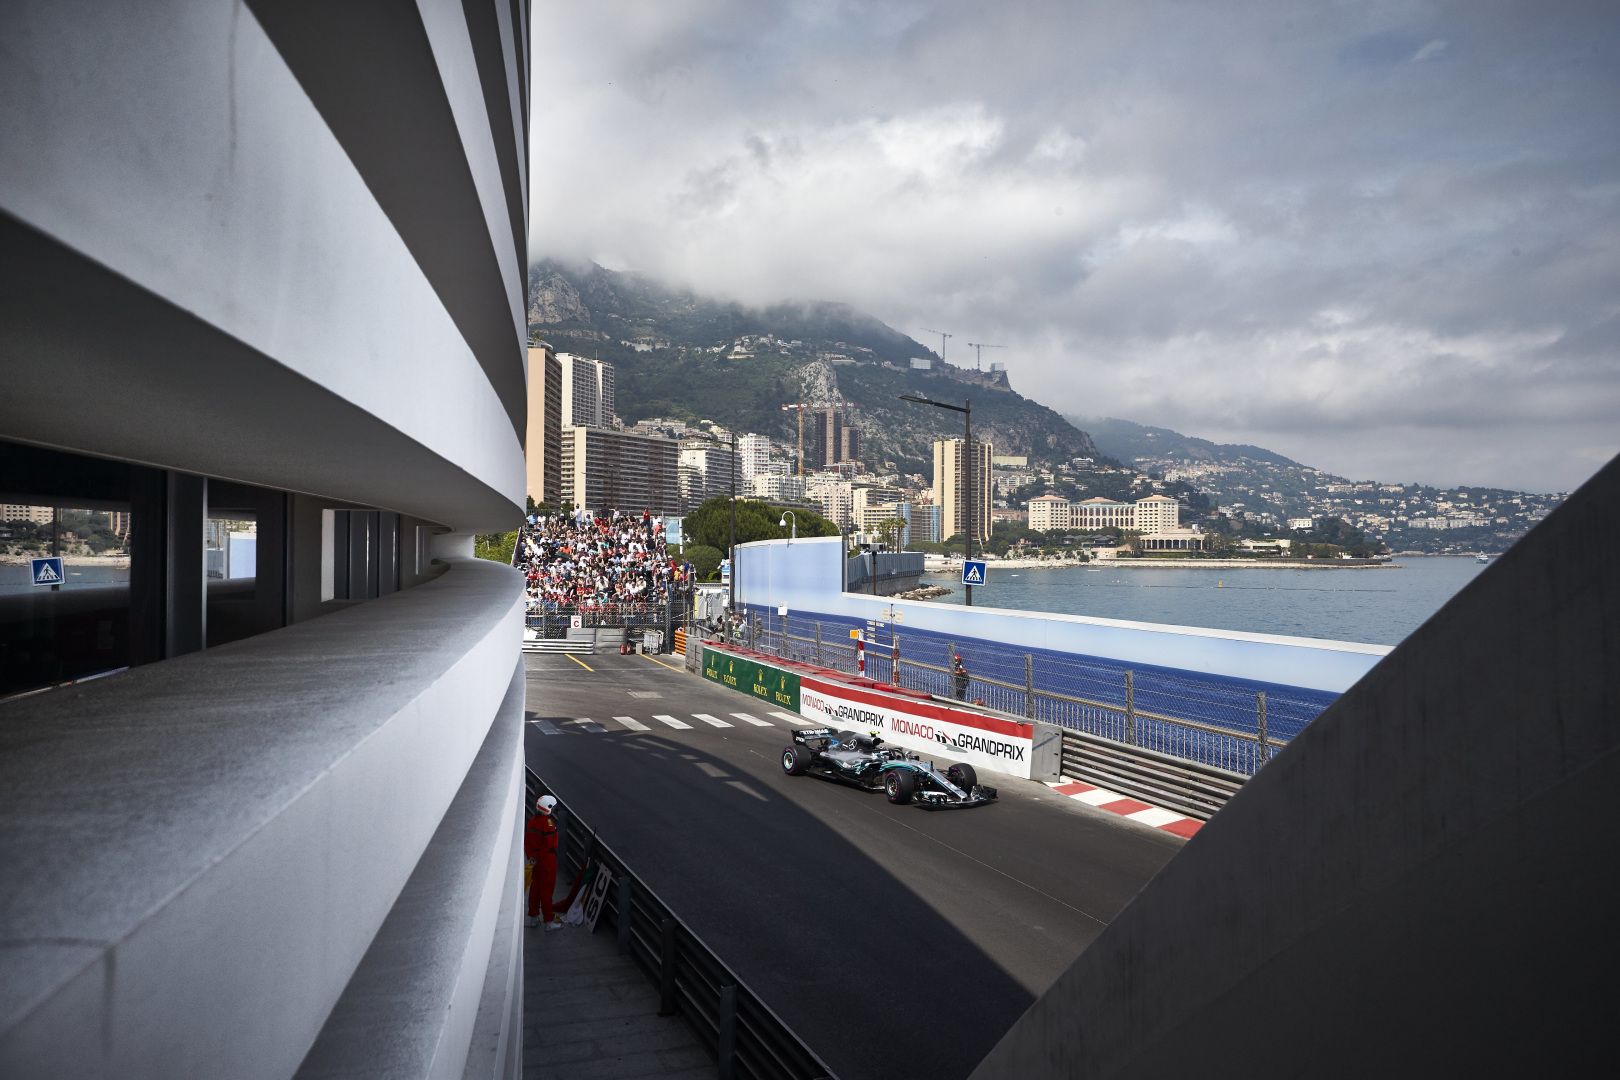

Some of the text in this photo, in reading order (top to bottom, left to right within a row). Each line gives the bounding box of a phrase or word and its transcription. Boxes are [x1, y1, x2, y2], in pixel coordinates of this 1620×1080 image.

[573, 620, 580, 628] C
[753, 683, 768, 697] ROLEX
[775, 691, 791, 705] ROLEX
[801, 694, 884, 728] MONACO GRANDPRIX
[891, 718, 1025, 761] MONACO GRANDPRIX
[586, 872, 607, 923] SC
